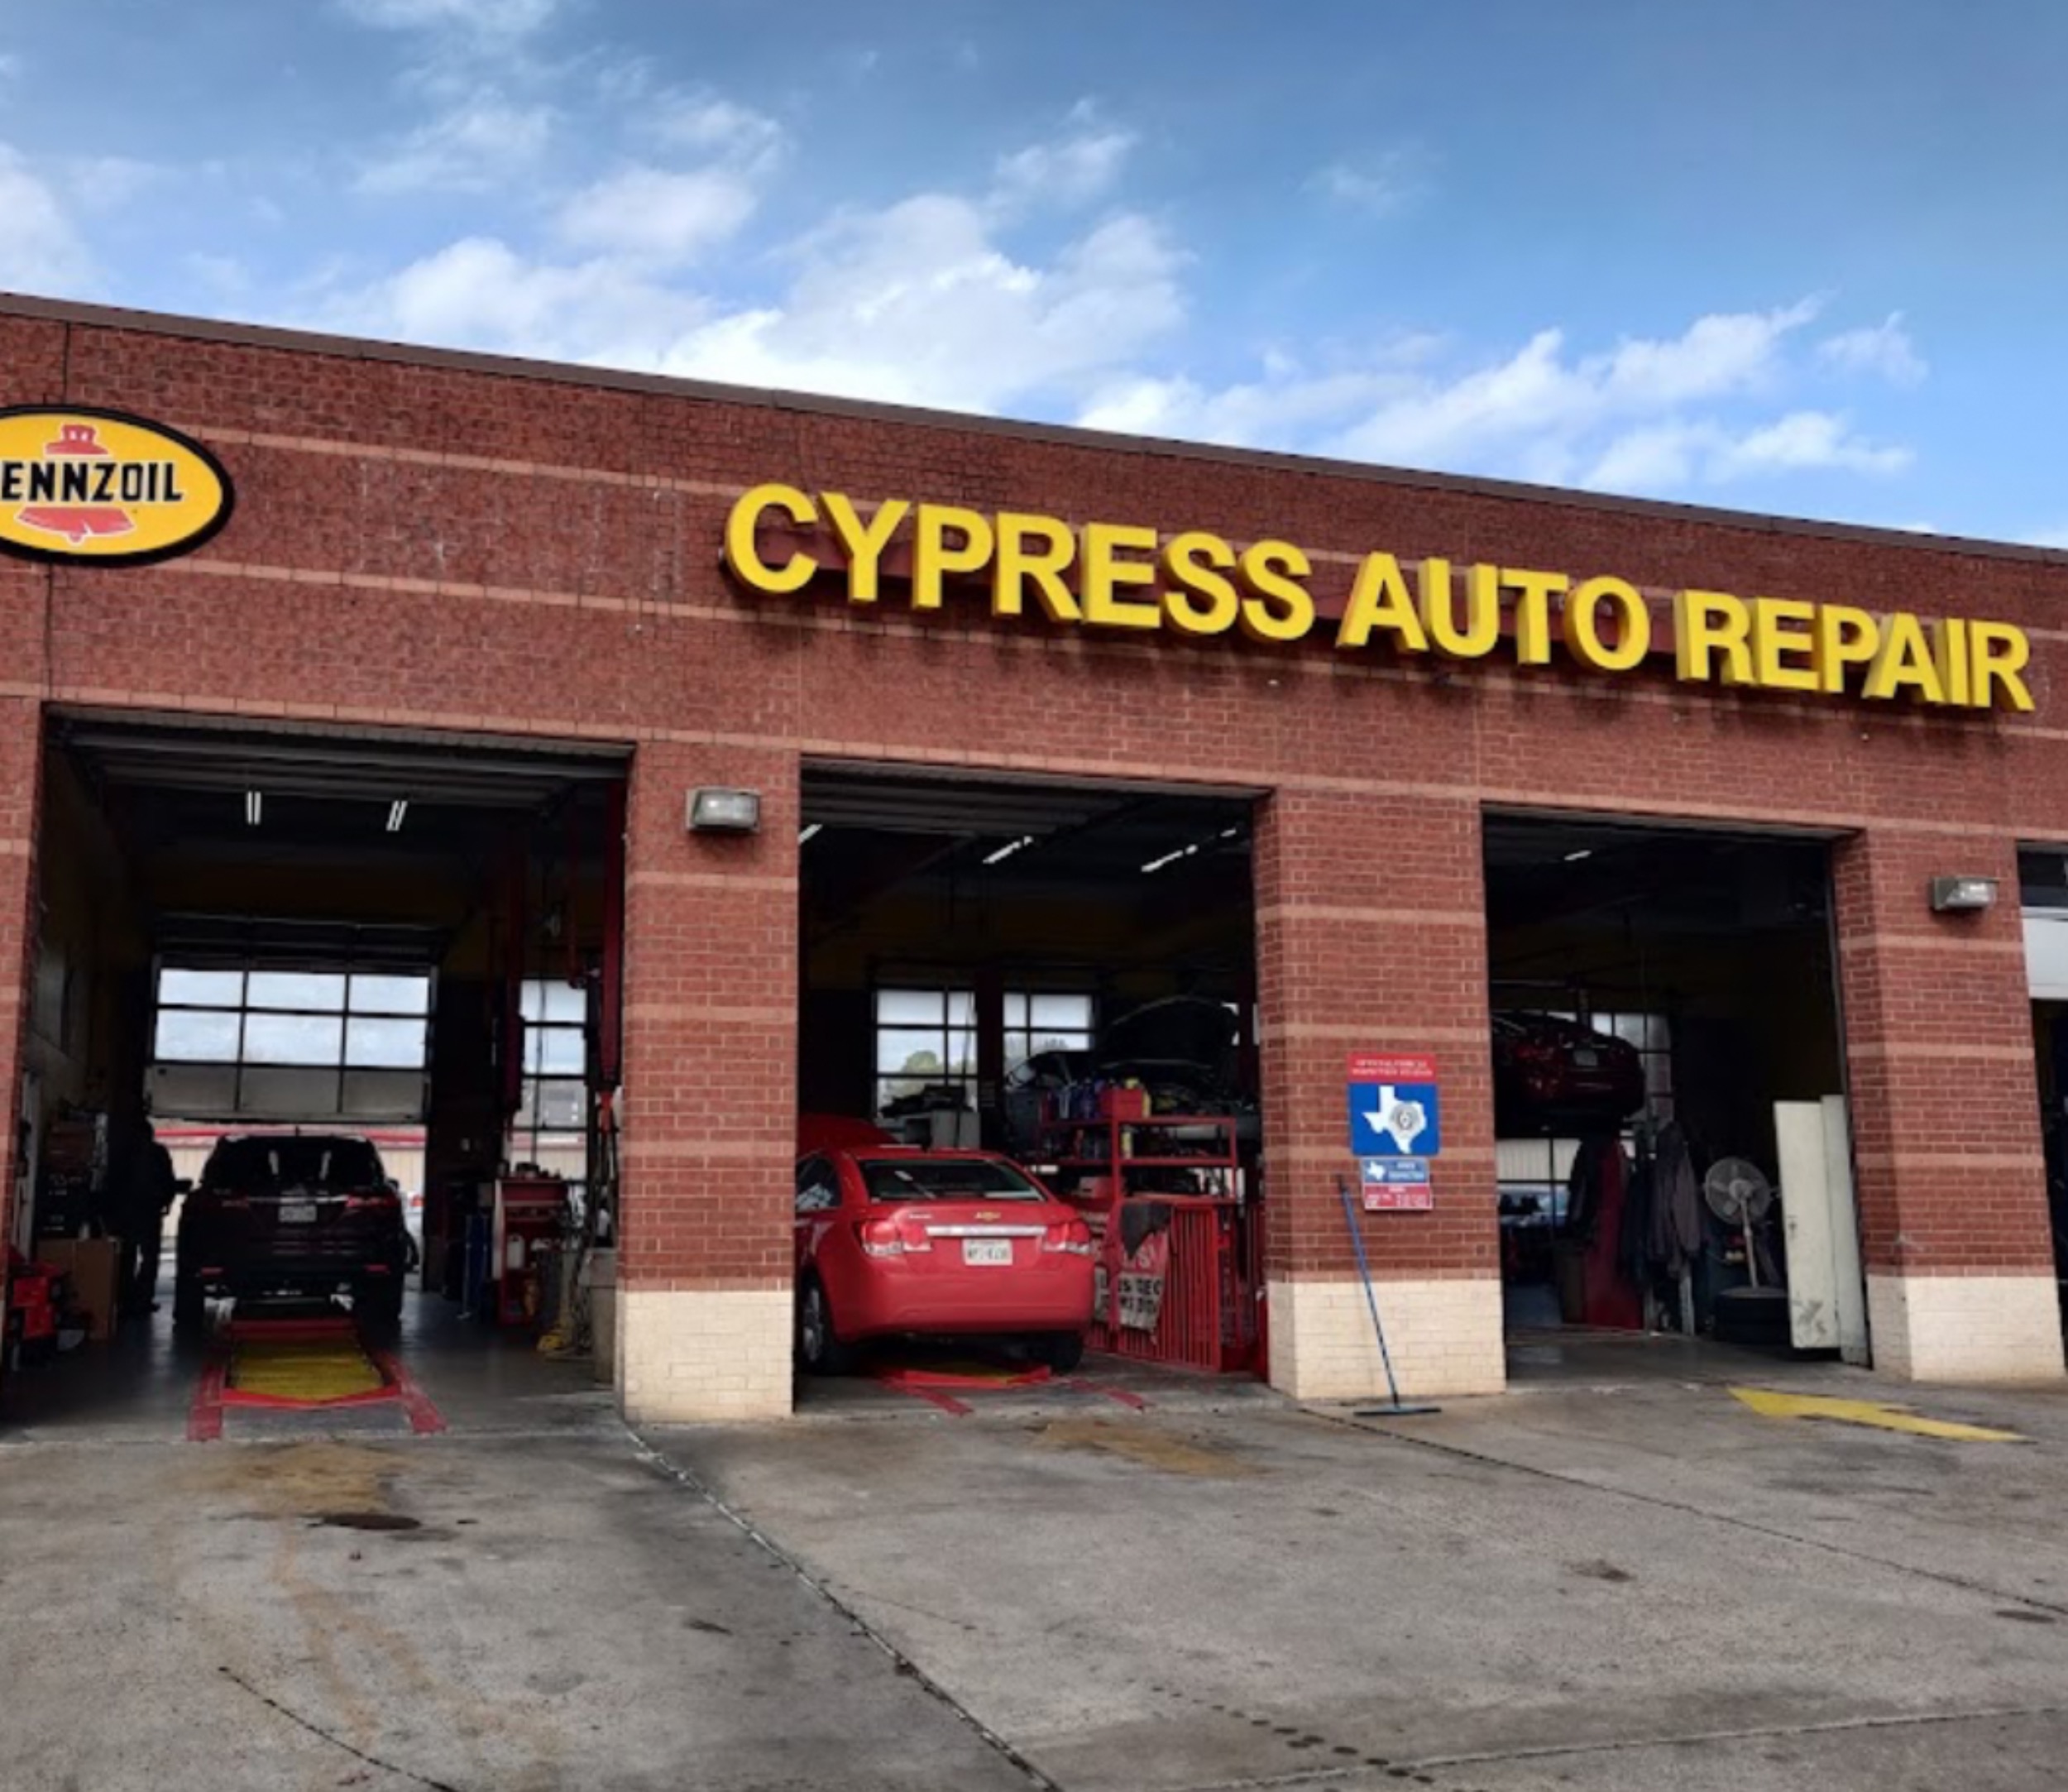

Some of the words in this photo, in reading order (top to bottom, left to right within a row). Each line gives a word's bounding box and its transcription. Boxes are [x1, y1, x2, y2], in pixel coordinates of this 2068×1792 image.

[0, 461, 184, 501] ENNZOIL
[725, 483, 1316, 641] CYPRESS
[1336, 552, 1650, 671] AUTO
[1674, 589, 2035, 711] REPAIR
